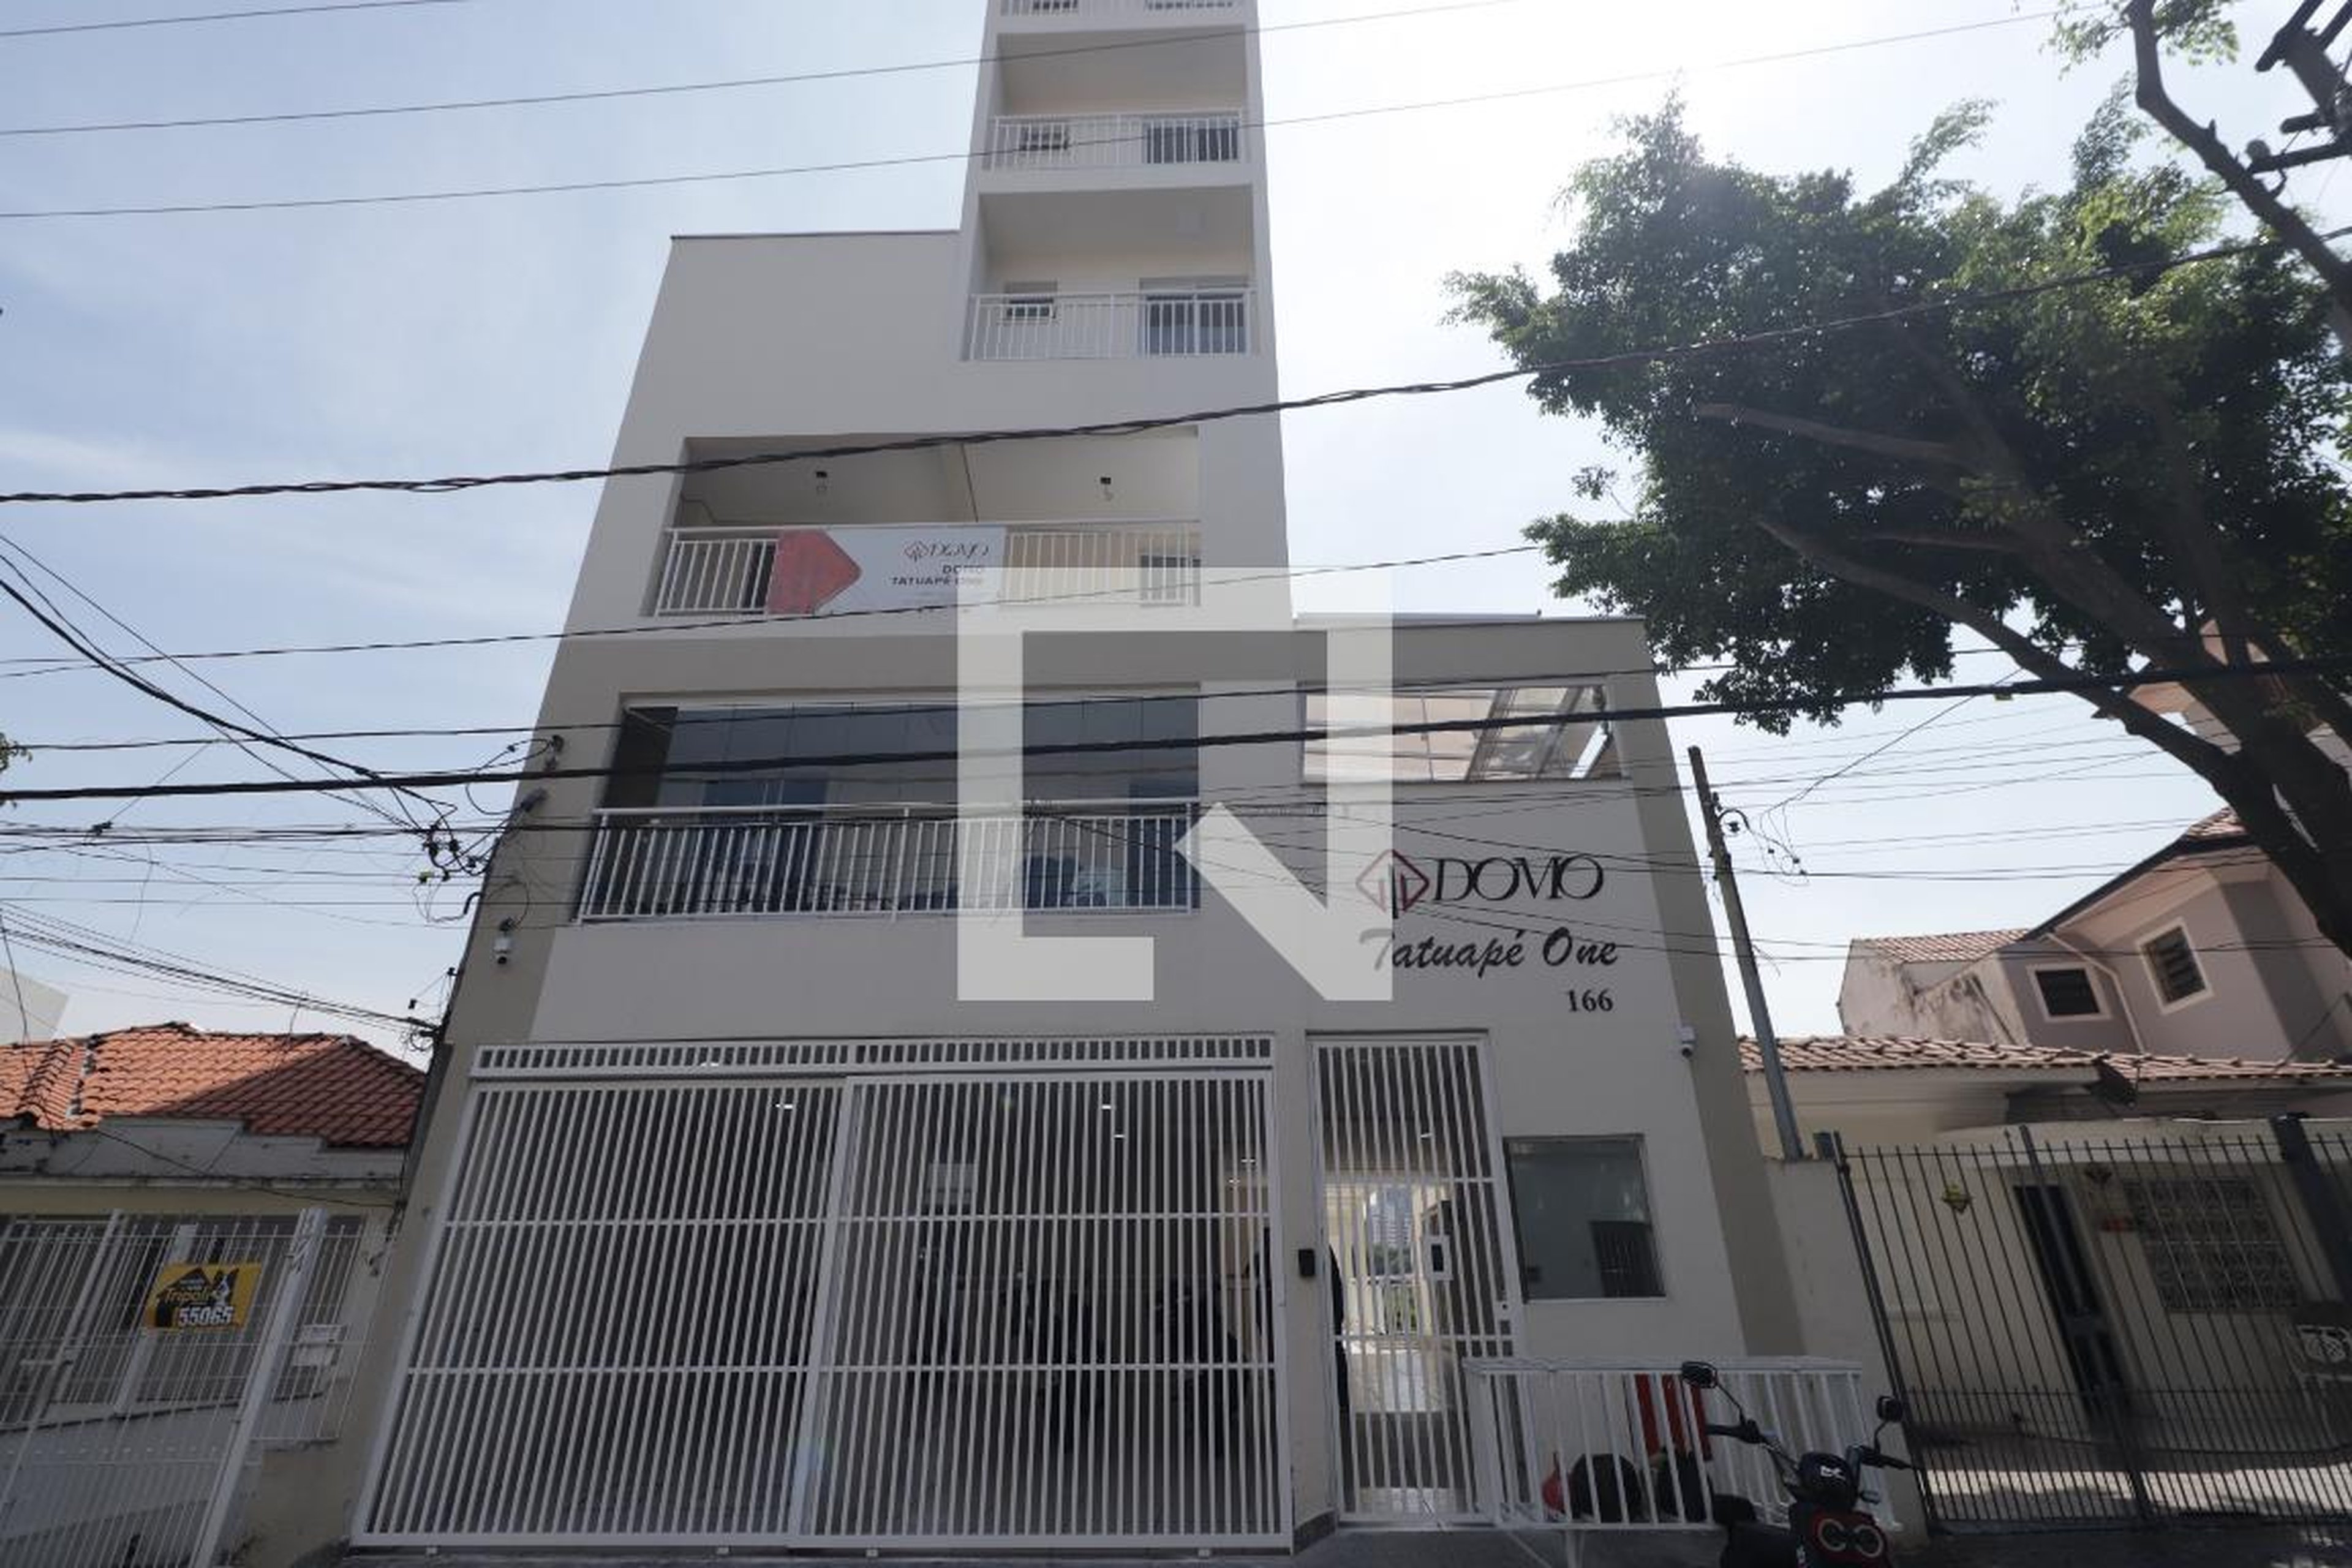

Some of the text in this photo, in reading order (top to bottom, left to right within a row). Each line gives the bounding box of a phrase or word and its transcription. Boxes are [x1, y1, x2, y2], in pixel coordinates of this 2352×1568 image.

[1433, 854, 1604, 901] DOMO
[1359, 926, 1618, 978] Tatuapé One
[1567, 989, 1613, 1012] 166
